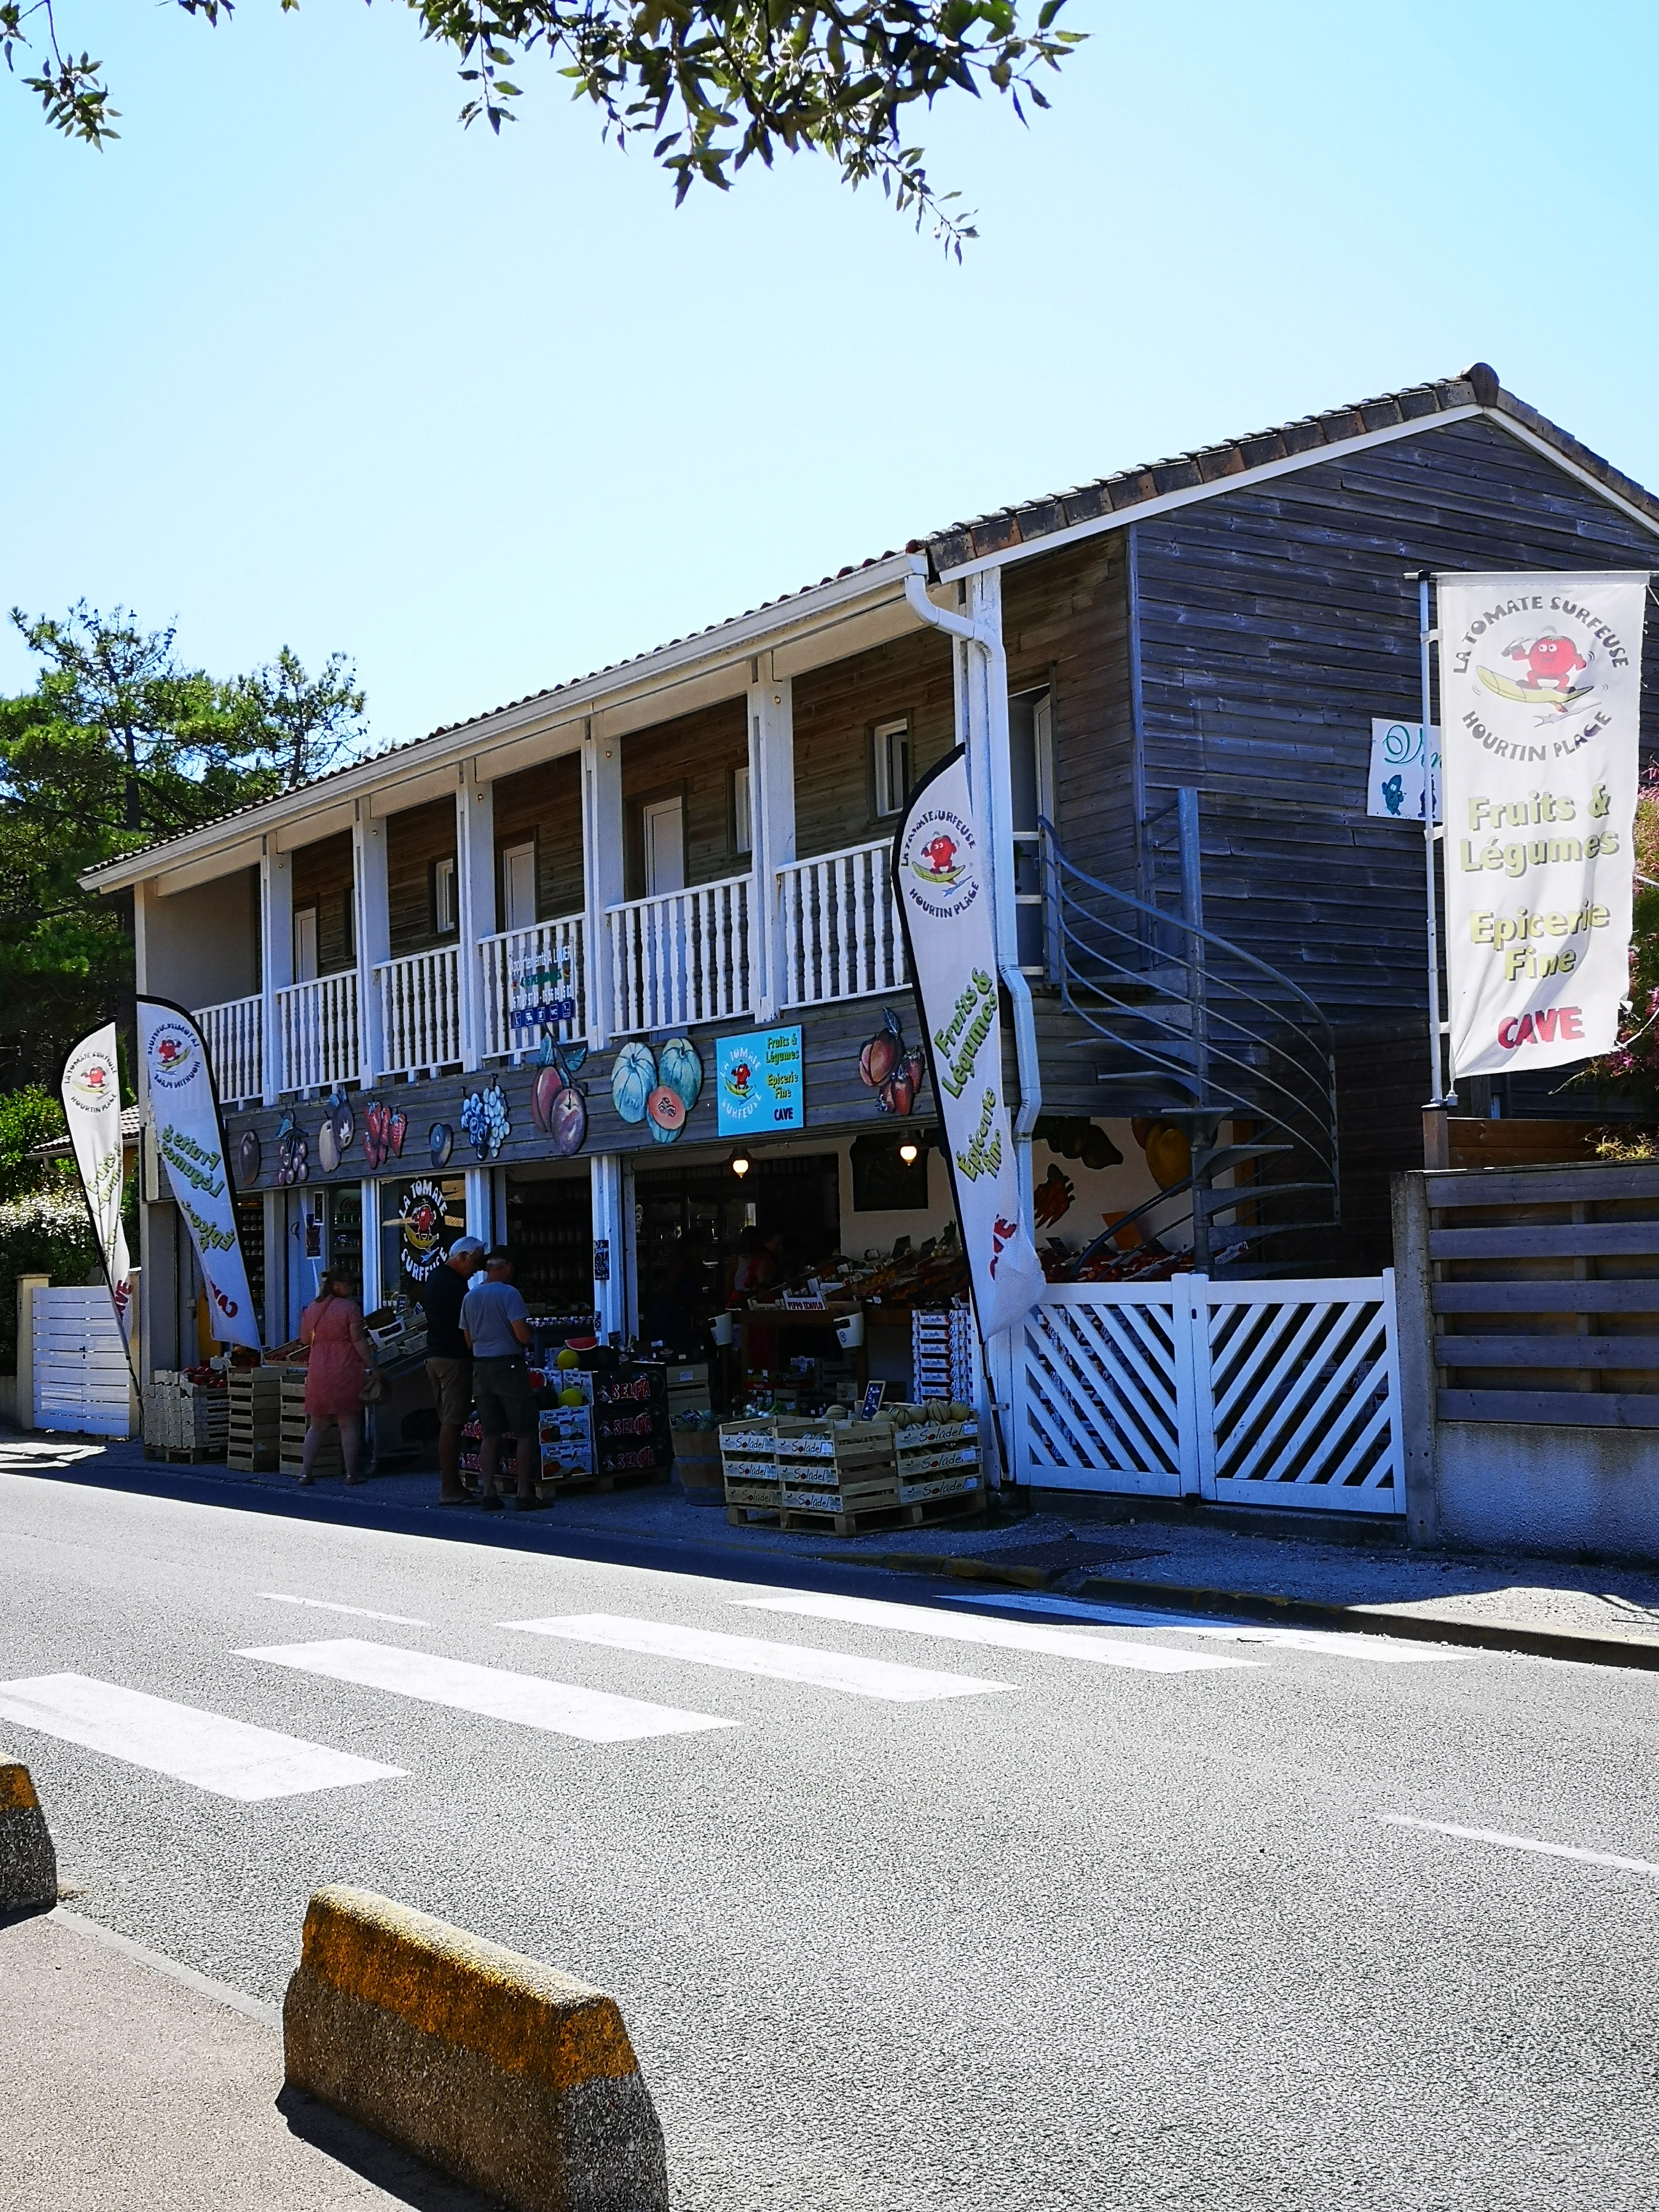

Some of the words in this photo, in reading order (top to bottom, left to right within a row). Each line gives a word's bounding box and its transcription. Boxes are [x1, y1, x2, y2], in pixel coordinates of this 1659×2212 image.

[1462, 596, 1543, 645] TOMATE
[1549, 596, 1629, 668] SURFEUSE
[1453, 650, 1472, 674] LA
[1461, 710, 1546, 762] HOURTIN
[1553, 711, 1612, 758] PLAGE
[1468, 789, 1577, 831] Fruits
[1588, 782, 1612, 819] &
[1460, 830, 1620, 878] Légumes
[909, 888, 953, 918] HOURTIN
[953, 881, 979, 915] PLAGE
[1470, 898, 1610, 952] Epicerie
[553, 945, 572, 963] LOUER
[1504, 944, 1577, 981] Fine
[933, 984, 977, 1059] Fruits
[971, 967, 993, 995] &
[1498, 1006, 1586, 1048] CAVE
[767, 1035, 789, 1050] Fruits
[791, 1033, 798, 1045] &
[941, 988, 997, 1099] Légumes
[729, 1047, 762, 1072] TOMATE
[765, 1050, 800, 1066] Légumes
[719, 1061, 729, 1079] LA
[767, 1071, 799, 1088] Epicerie
[71, 1096, 101, 1113] HOURTIN
[102, 1093, 118, 1111] PLAGE
[774, 1087, 792, 1099] Fine
[722, 1091, 762, 1120] SURFEUSE
[774, 1107, 794, 1121] CAVE
[398, 1195, 411, 1219] LA
[410, 1179, 448, 1217] TOMATE
[787, 1301, 803, 1310] PIPPO
[611, 1377, 652, 1401] SELFA
[613, 1412, 652, 1436] SELFA
[919, 1424, 964, 1443] Soladel
[736, 1436, 766, 1449] Soladel
[791, 1440, 822, 1453] Soladel
[617, 1446, 656, 1469] SELFA
[921, 1453, 963, 1469] Solade
[739, 1463, 767, 1476] Soladel
[794, 1467, 826, 1481] Soladel
[742, 1489, 772, 1502] Soladel
[922, 1477, 967, 1496] Soladel
[798, 1493, 831, 1508] Soladel
